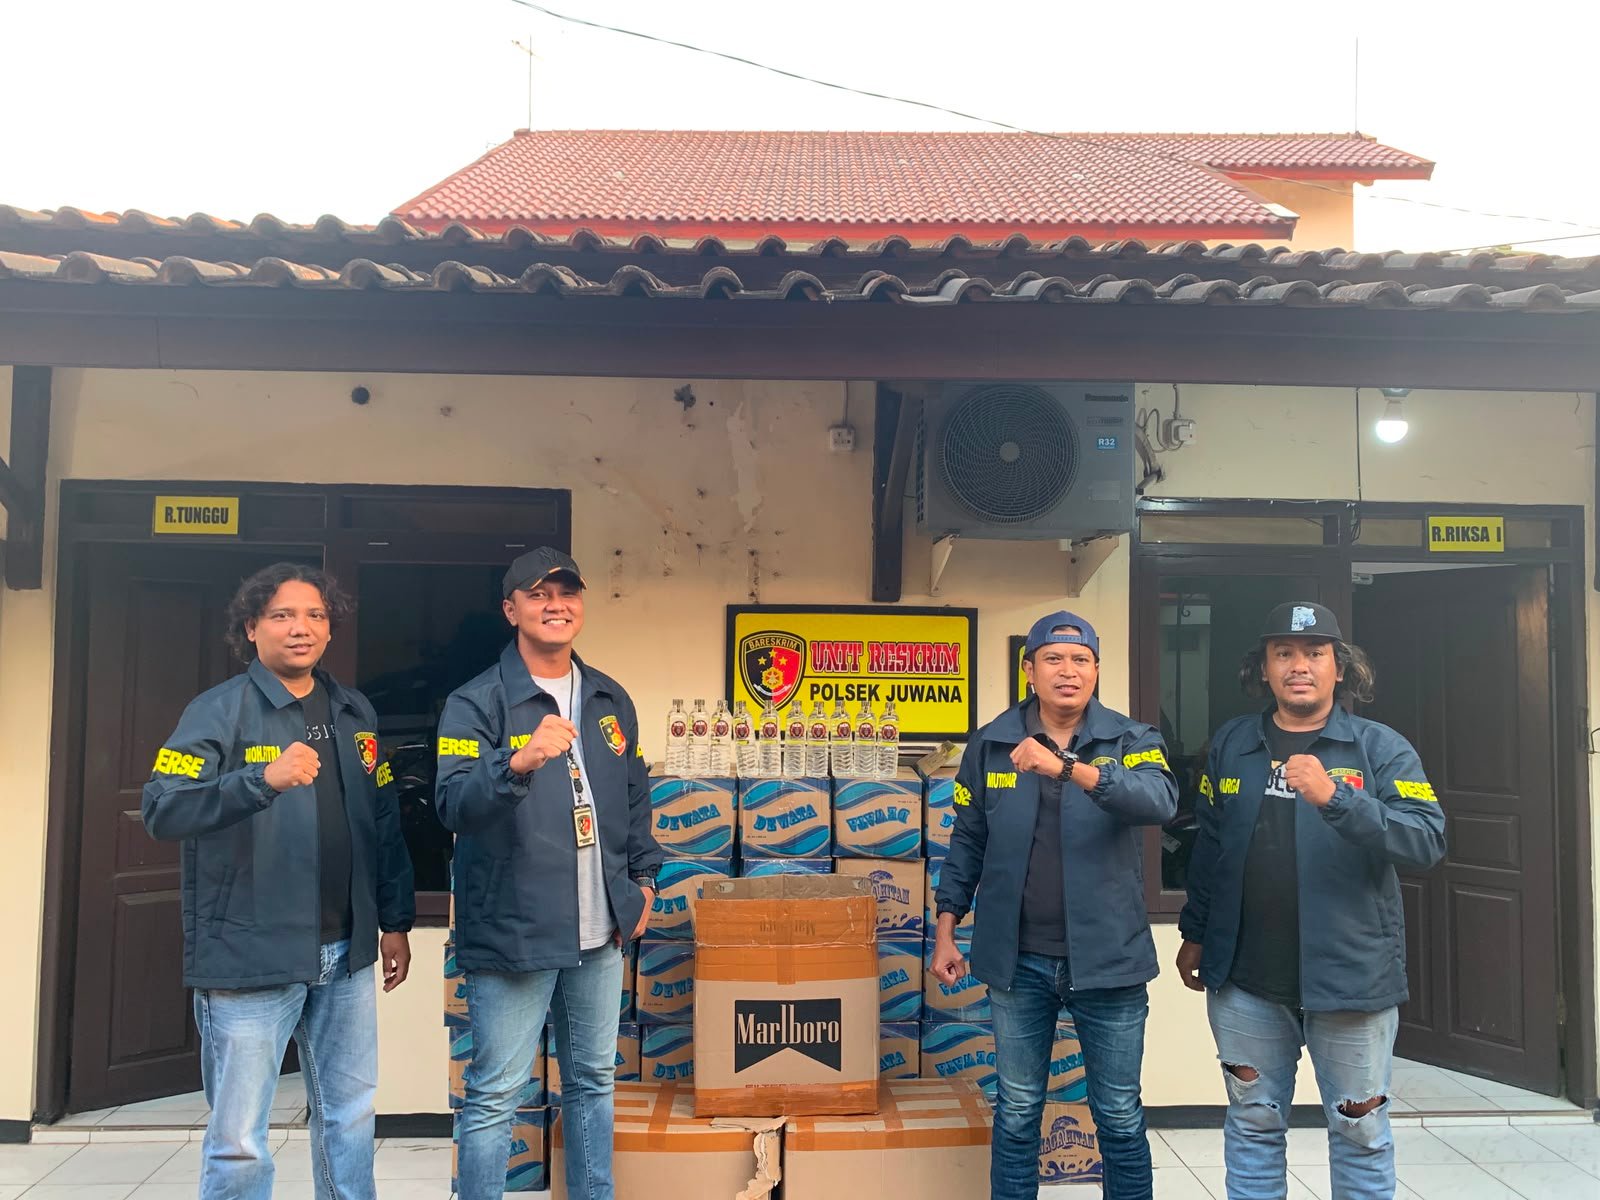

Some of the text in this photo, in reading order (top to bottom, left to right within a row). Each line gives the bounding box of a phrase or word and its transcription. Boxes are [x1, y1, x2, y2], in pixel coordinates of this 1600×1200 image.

[1098, 438, 1115, 446] R32
[164, 506, 229, 524] R.TUNGGU
[1431, 526, 1490, 542] R.RIKSA
[748, 637, 798, 650] BARESKRIM
[810, 641, 960, 675] UNIT RESKRIM
[810, 684, 962, 702] POLSEK JUWANA
[152, 748, 205, 779] ERSE
[753, 803, 818, 832] DEWATA
[737, 1004, 840, 1045] Marlboro
